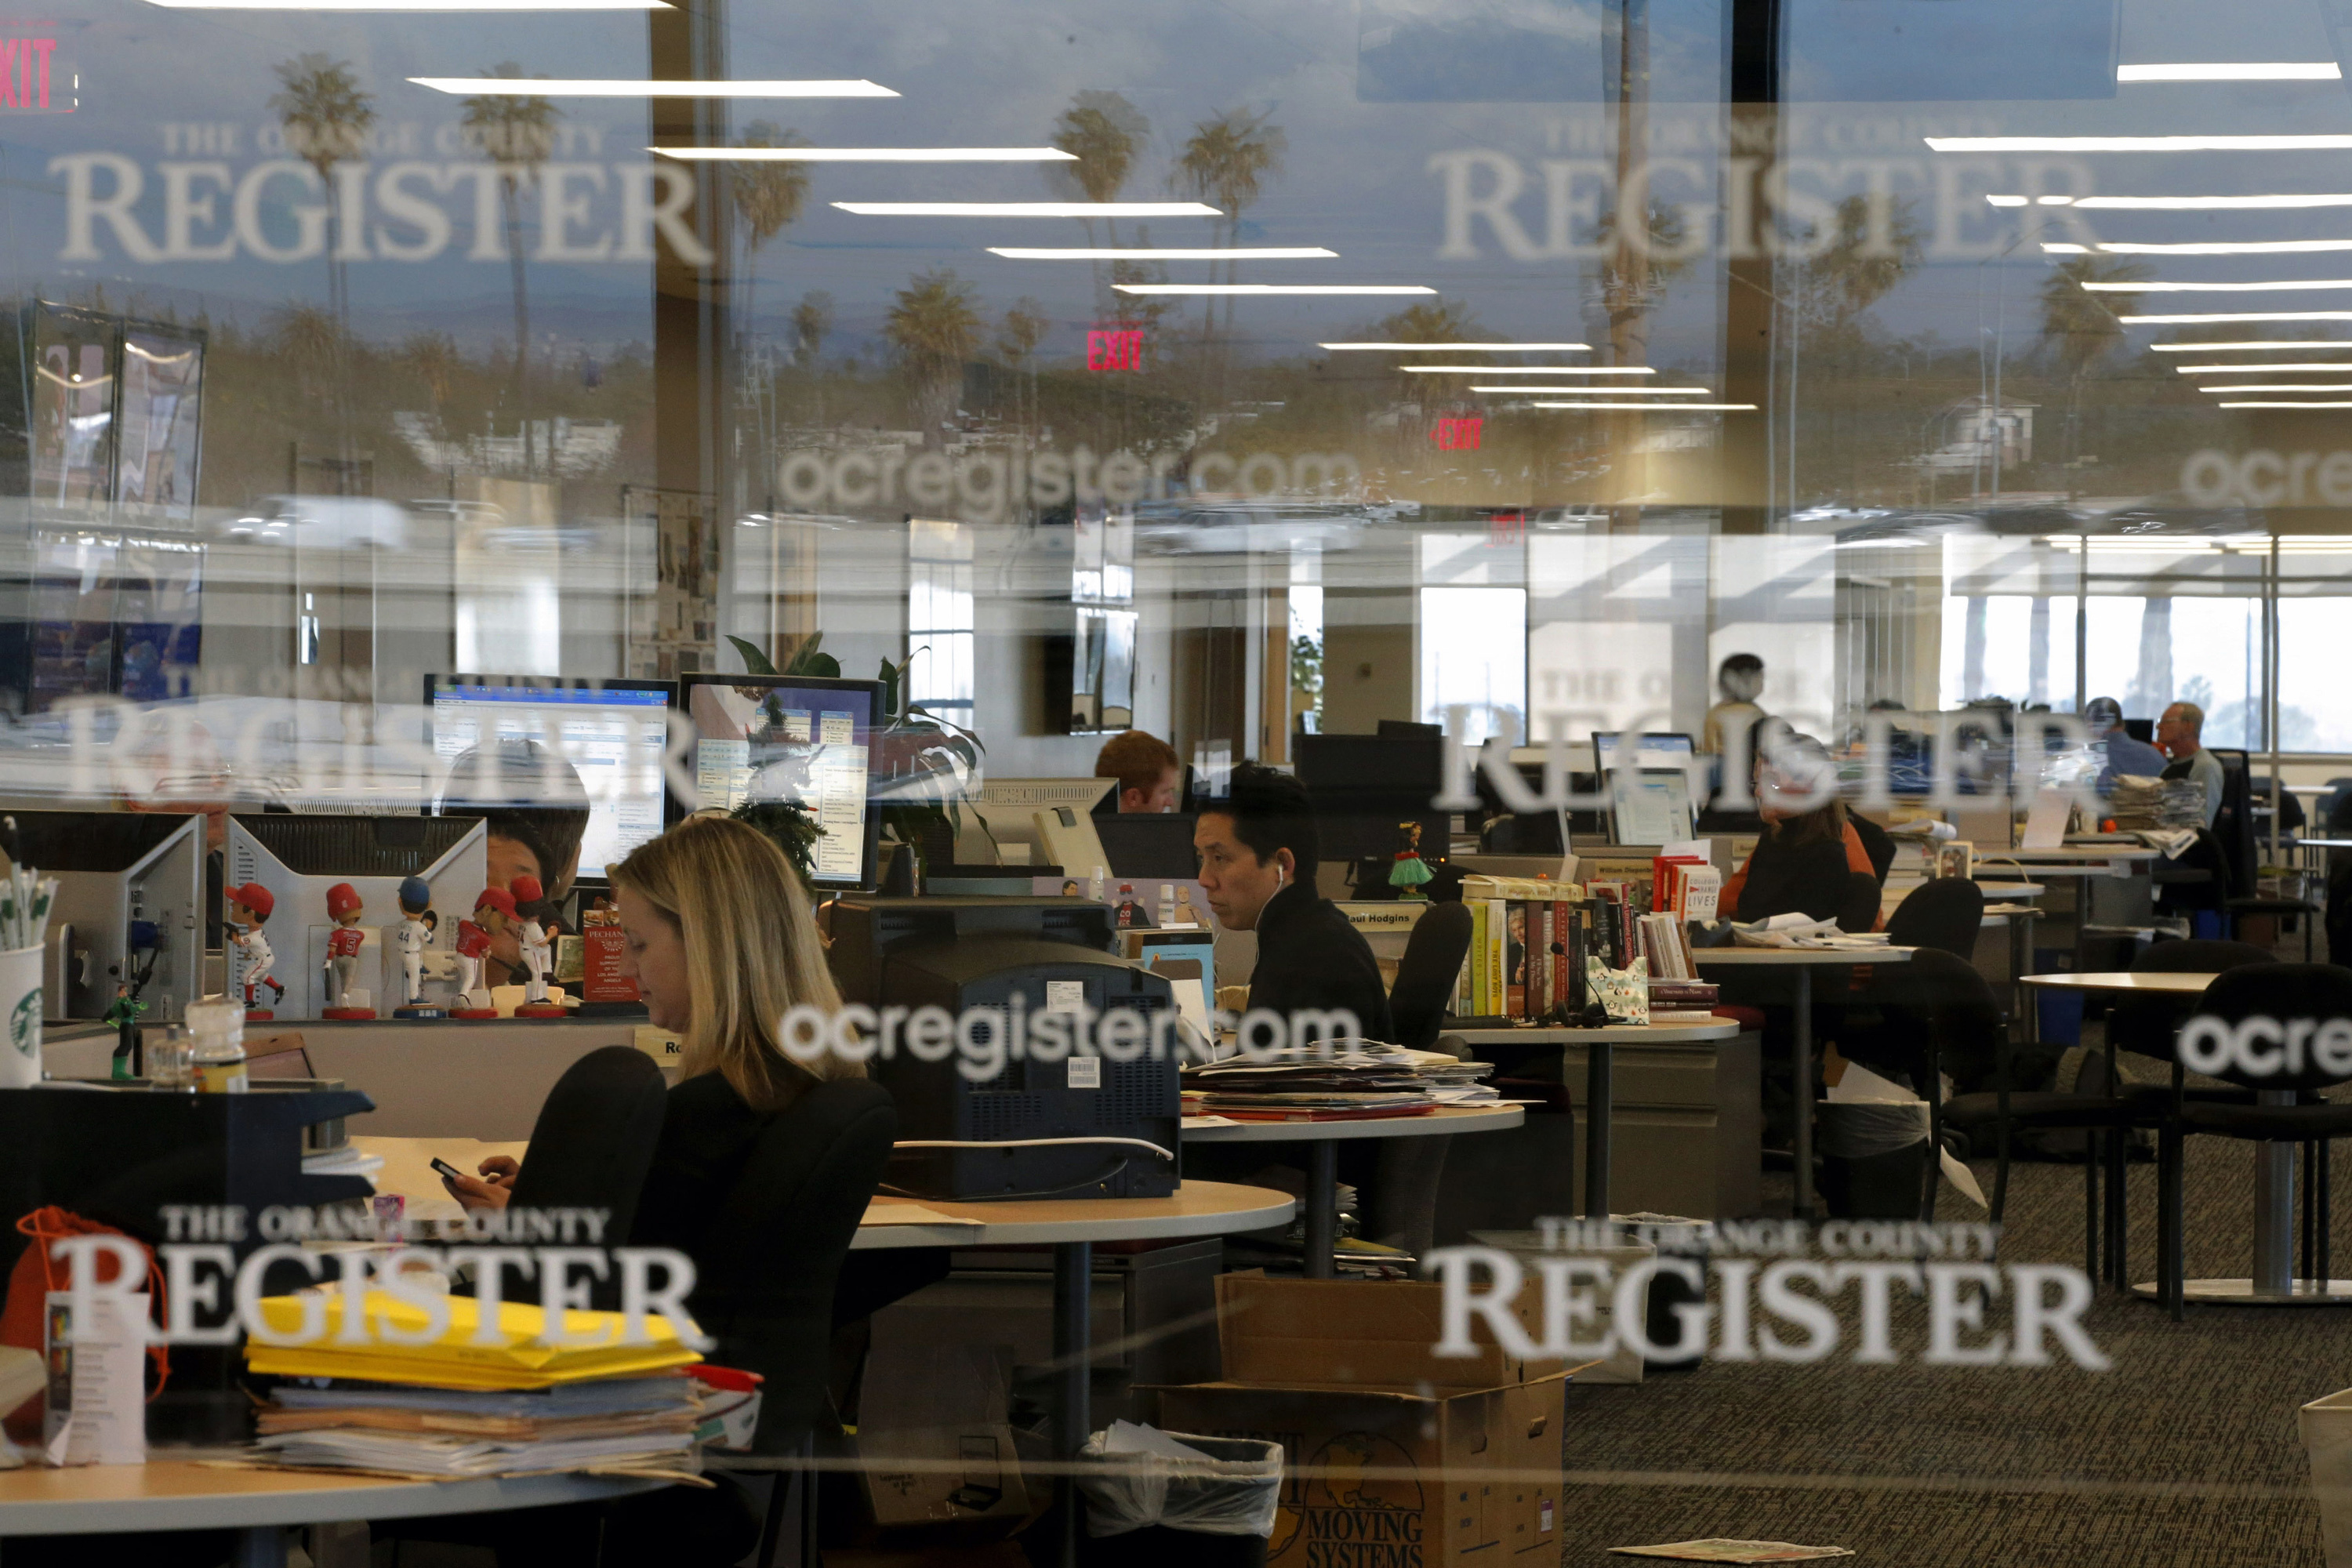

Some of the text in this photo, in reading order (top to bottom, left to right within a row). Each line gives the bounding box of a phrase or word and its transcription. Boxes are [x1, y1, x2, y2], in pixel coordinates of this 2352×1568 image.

[163, 122, 241, 156] THE
[48, 152, 716, 267] REGISTER
[1427, 147, 2107, 265] REGISTER
[1087, 329, 1143, 371] EXIT
[1439, 419, 1483, 450] EXIT
[1433, 701, 2114, 817] REGISTER
[1348, 913, 1410, 924] aul Hodgins
[1688, 895, 1716, 907] LIVES
[398, 931, 410, 944] 44
[1624, 908, 1632, 936] Ultimate
[347, 938, 357, 953] 5
[781, 991, 1363, 1083] ocregister.com
[2176, 1014, 2352, 1076] ocre
[161, 1205, 249, 1243] THE
[436, 1205, 614, 1244] COUNTY
[1534, 1215, 1621, 1251] THE
[1820, 1219, 2004, 1256] COUNTY
[49, 1233, 717, 1352] REGISTER
[1424, 1244, 2113, 1371] REGISTER
[1307, 1510, 1423, 1544] MOVING
[1306, 1542, 1423, 1568] SYSTEMS
